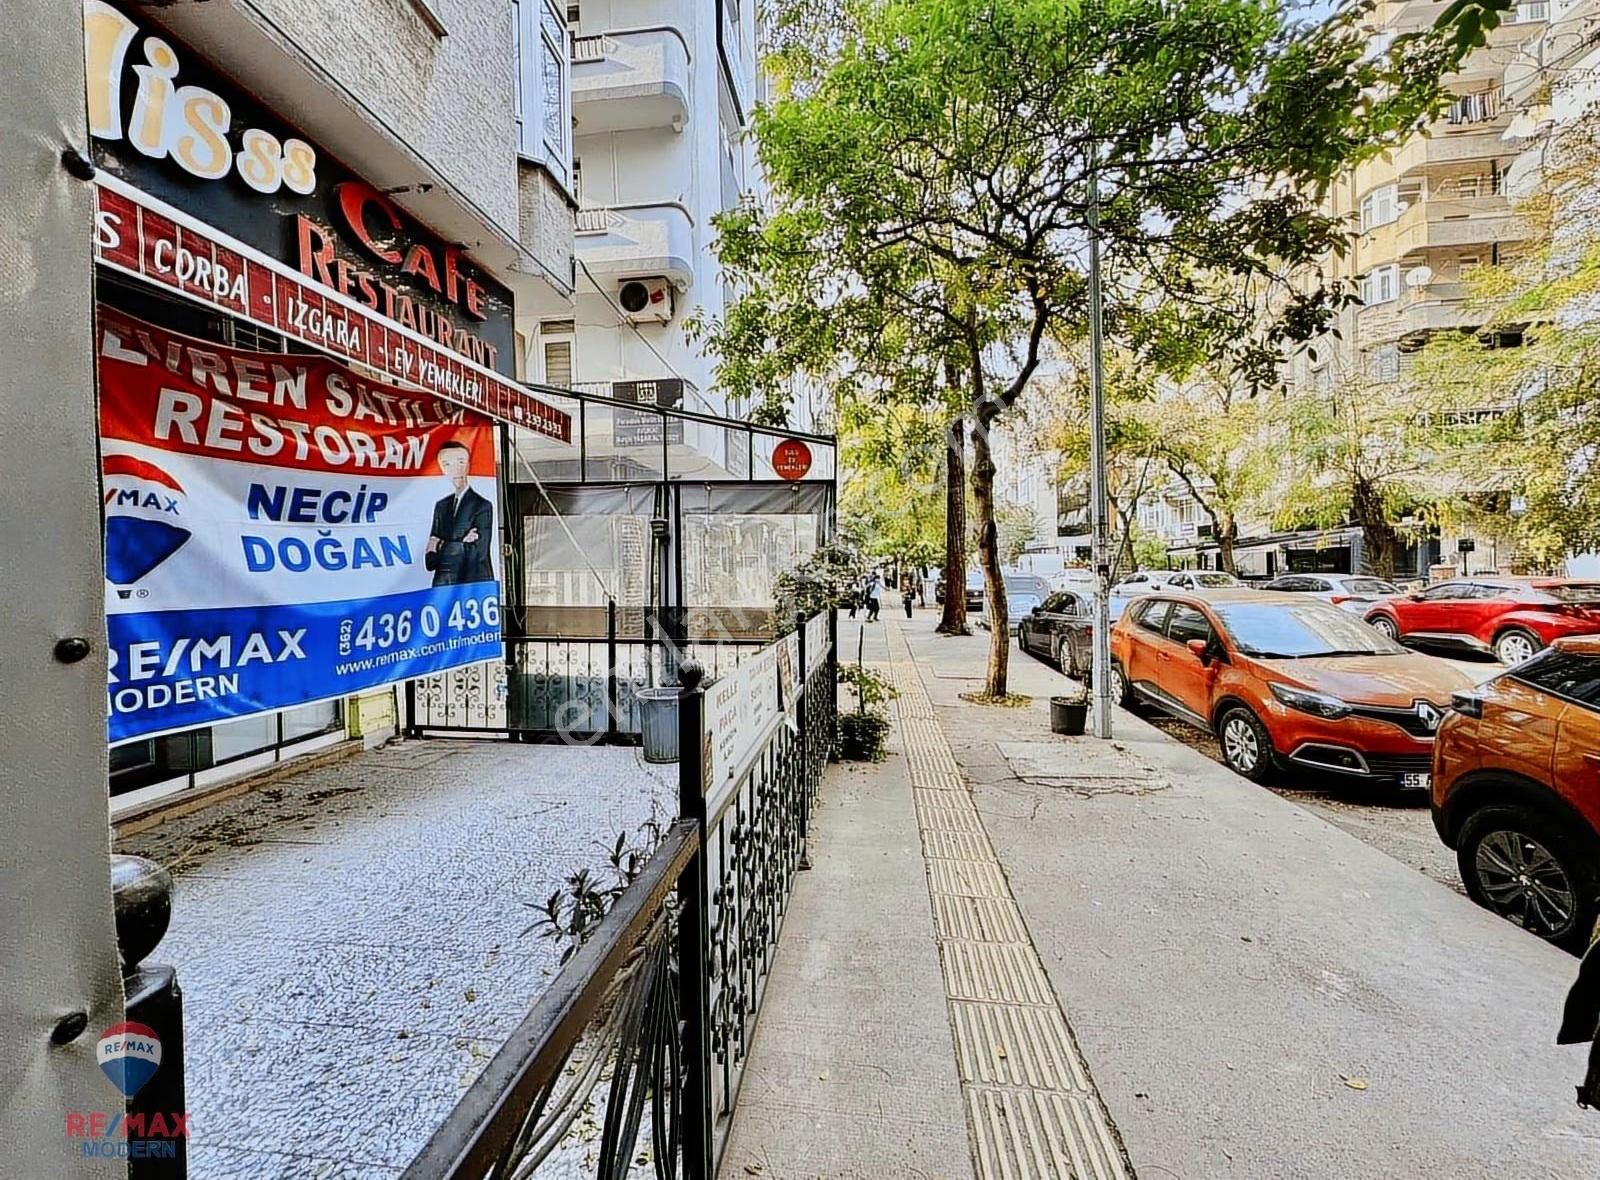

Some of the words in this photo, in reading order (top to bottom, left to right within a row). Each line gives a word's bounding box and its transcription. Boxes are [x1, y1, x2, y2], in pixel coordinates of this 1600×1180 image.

[153, 238, 246, 307] ÇORBA
[394, 347, 414, 374] EV
[297, 213, 497, 370] RESTAURANT
[154, 387, 430, 469] RESTORAN
[247, 483, 388, 524] NECİP
[241, 529, 412, 573] DOĞAN
[339, 619, 354, 656] (362)
[355, 609, 412, 651] 436
[420, 605, 440, 638] 0
[448, 596, 499, 632] 436
